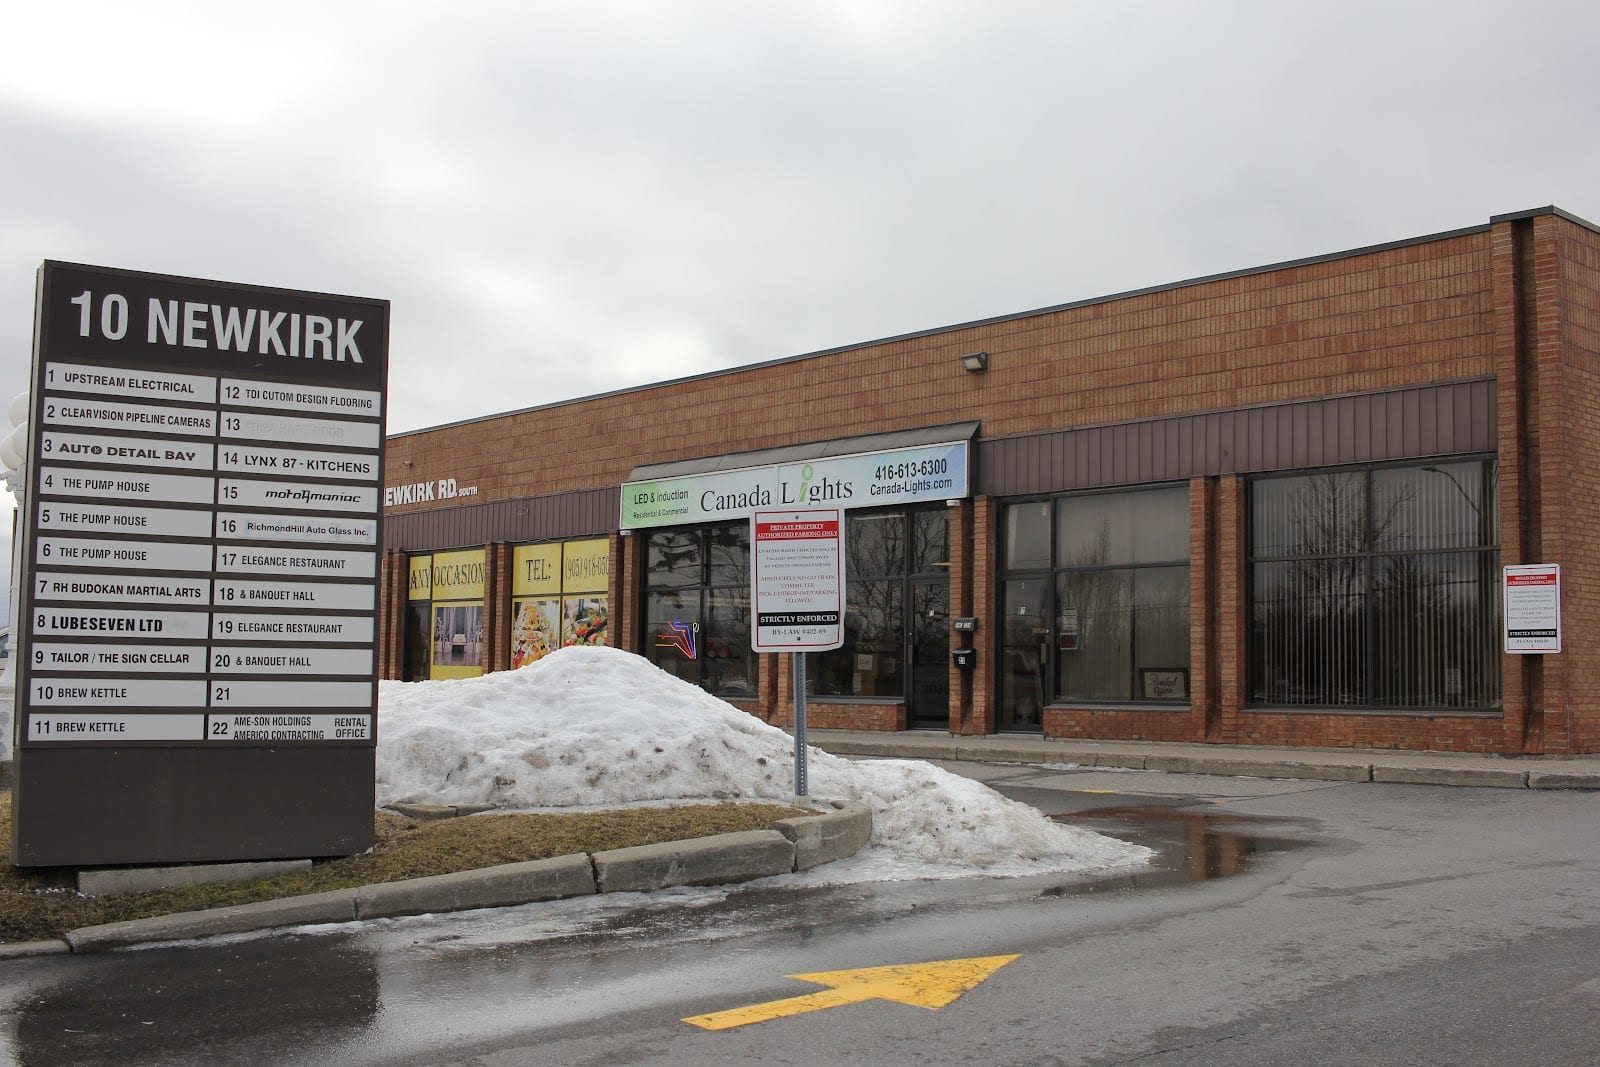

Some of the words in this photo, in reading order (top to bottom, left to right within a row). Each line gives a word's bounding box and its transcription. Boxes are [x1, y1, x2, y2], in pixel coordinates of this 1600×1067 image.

[70, 289, 129, 341] 10
[147, 297, 364, 364] NEWKIRK
[48, 369, 54, 383] 1
[64, 372, 125, 388] UPSTREAM
[128, 378, 194, 394] ELECTRICAL
[225, 386, 240, 399] 12
[245, 389, 260, 400] TDI
[262, 390, 294, 402] CUTOM
[296, 393, 328, 405] DESIGN
[330, 396, 372, 409] FLOORING
[47, 405, 55, 418] 2
[61, 407, 124, 421] CLEARVISION
[126, 412, 165, 425] PIPELINE
[167, 416, 211, 428] CAMERAS
[226, 418, 240, 431] 13
[44, 439, 52, 452] 3
[59, 443, 103, 454] AUTO
[107, 446, 161, 459] DETAIL
[165, 450, 196, 461] BAY
[224, 452, 238, 465] 14
[244, 455, 277, 467] LYNX
[282, 458, 296, 468] 87
[307, 459, 370, 473] KITCHENS
[875, 458, 947, 481] 416-613-6300
[44, 475, 53, 488] 4
[63, 478, 82, 489] THE
[85, 479, 114, 491] PUMP
[117, 481, 150, 493] HOUSE
[458, 486, 478, 496] SOUTH
[781, 464, 853, 505] Lights
[870, 478, 952, 496] Canada-Lights.com
[223, 486, 238, 499] 15
[634, 493, 648, 505] LED
[650, 492, 655, 503] &
[656, 489, 689, 502] Induction
[700, 484, 771, 512] Canada
[42, 509, 50, 523] 5
[59, 512, 78, 523] THE
[81, 513, 110, 525] PUMP
[113, 515, 147, 527] HOUSE
[633, 509, 658, 519] Residential
[662, 507, 689, 516] Commercial
[221, 519, 236, 533] 16
[247, 522, 305, 533] RichmondHill
[306, 526, 326, 534] Auto
[328, 527, 352, 536] Glass
[354, 528, 369, 536] Inc.
[42, 544, 51, 557] 6
[59, 547, 78, 558] THE
[81, 548, 110, 560] PUMP
[113, 550, 147, 561] HOUSE
[221, 553, 236, 566] 17
[241, 555, 287, 567] ELEGANCE
[289, 557, 346, 569] RESTAURANT
[526, 558, 551, 581] TEL:
[565, 556, 582, 580] (905)
[410, 565, 432, 590] ANY
[434, 563, 485, 586] OCCASION
[40, 580, 48, 593] 7
[53, 582, 68, 593] RH
[72, 583, 124, 595] BUDOKAN
[126, 586, 172, 597] MARTIAL
[174, 587, 201, 598] ARTS
[219, 587, 234, 601] 18
[240, 590, 247, 599] &
[249, 590, 291, 601] BANQUET
[293, 591, 315, 601] HALL
[37, 614, 46, 628] 8
[51, 615, 135, 632] LUBESEVEN
[139, 619, 163, 632] LTD
[760, 615, 796, 623] STRICTLY
[797, 614, 837, 622] ENFORCED
[218, 620, 233, 634] 19
[238, 622, 284, 633] ELEGANCE
[286, 624, 342, 634] RESTAURANT
[35, 650, 44, 664] 9
[51, 652, 89, 663] TAILOR
[98, 653, 118, 664] THE
[121, 654, 147, 664] SIGN
[150, 654, 189, 664] CELLAR
[215, 654, 230, 667] 20
[236, 656, 242, 666] &
[245, 656, 287, 667] BANQUET
[289, 657, 311, 667] HALL
[37, 686, 53, 700] 10
[58, 688, 88, 698] BREW
[91, 688, 127, 698] KETTLE
[216, 687, 230, 700] 21
[36, 720, 50, 734] 11
[56, 722, 86, 732] BREW
[89, 722, 125, 732] KETTLE
[212, 722, 228, 735] 22
[234, 717, 270, 726] AME-SON
[272, 716, 311, 726] HOLDINGS
[334, 718, 366, 727] RENTAL
[234, 730, 269, 740] AMERICO
[271, 730, 324, 740] CONTRACTING
[336, 729, 365, 738] OFFICE
